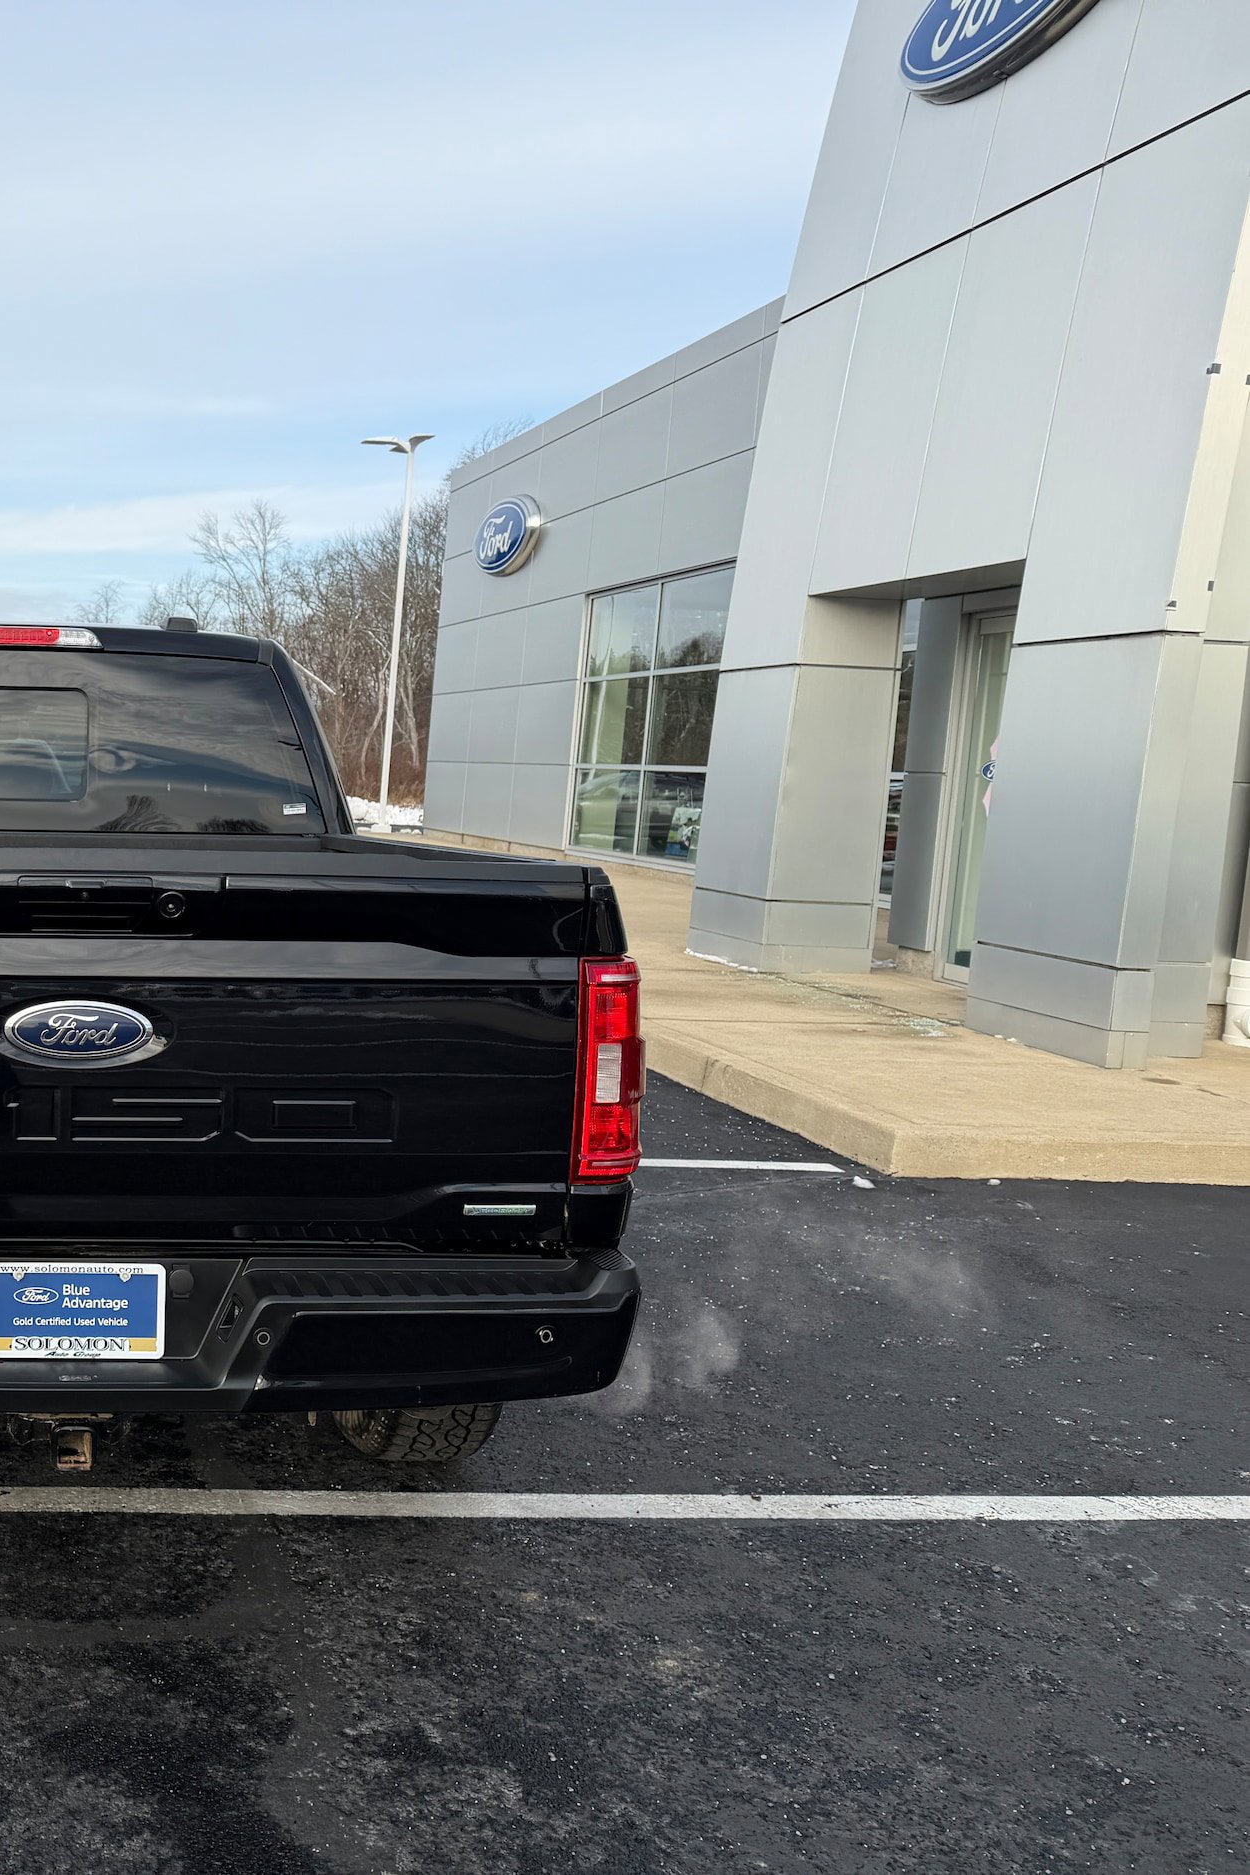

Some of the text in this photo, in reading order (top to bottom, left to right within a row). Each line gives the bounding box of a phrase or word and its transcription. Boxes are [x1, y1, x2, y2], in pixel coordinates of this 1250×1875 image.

[479, 514, 514, 560] Ford
[40, 1013, 119, 1046] Ford
[0, 1264, 144, 1274] www.solomonauto.com
[21, 1289, 51, 1302] Ford
[62, 1284, 91, 1296] Blue
[61, 1297, 129, 1311] Advantage
[12, 1317, 129, 1327] Gold Certified Used Vehicle
[14, 1337, 127, 1351] SOLOMON
